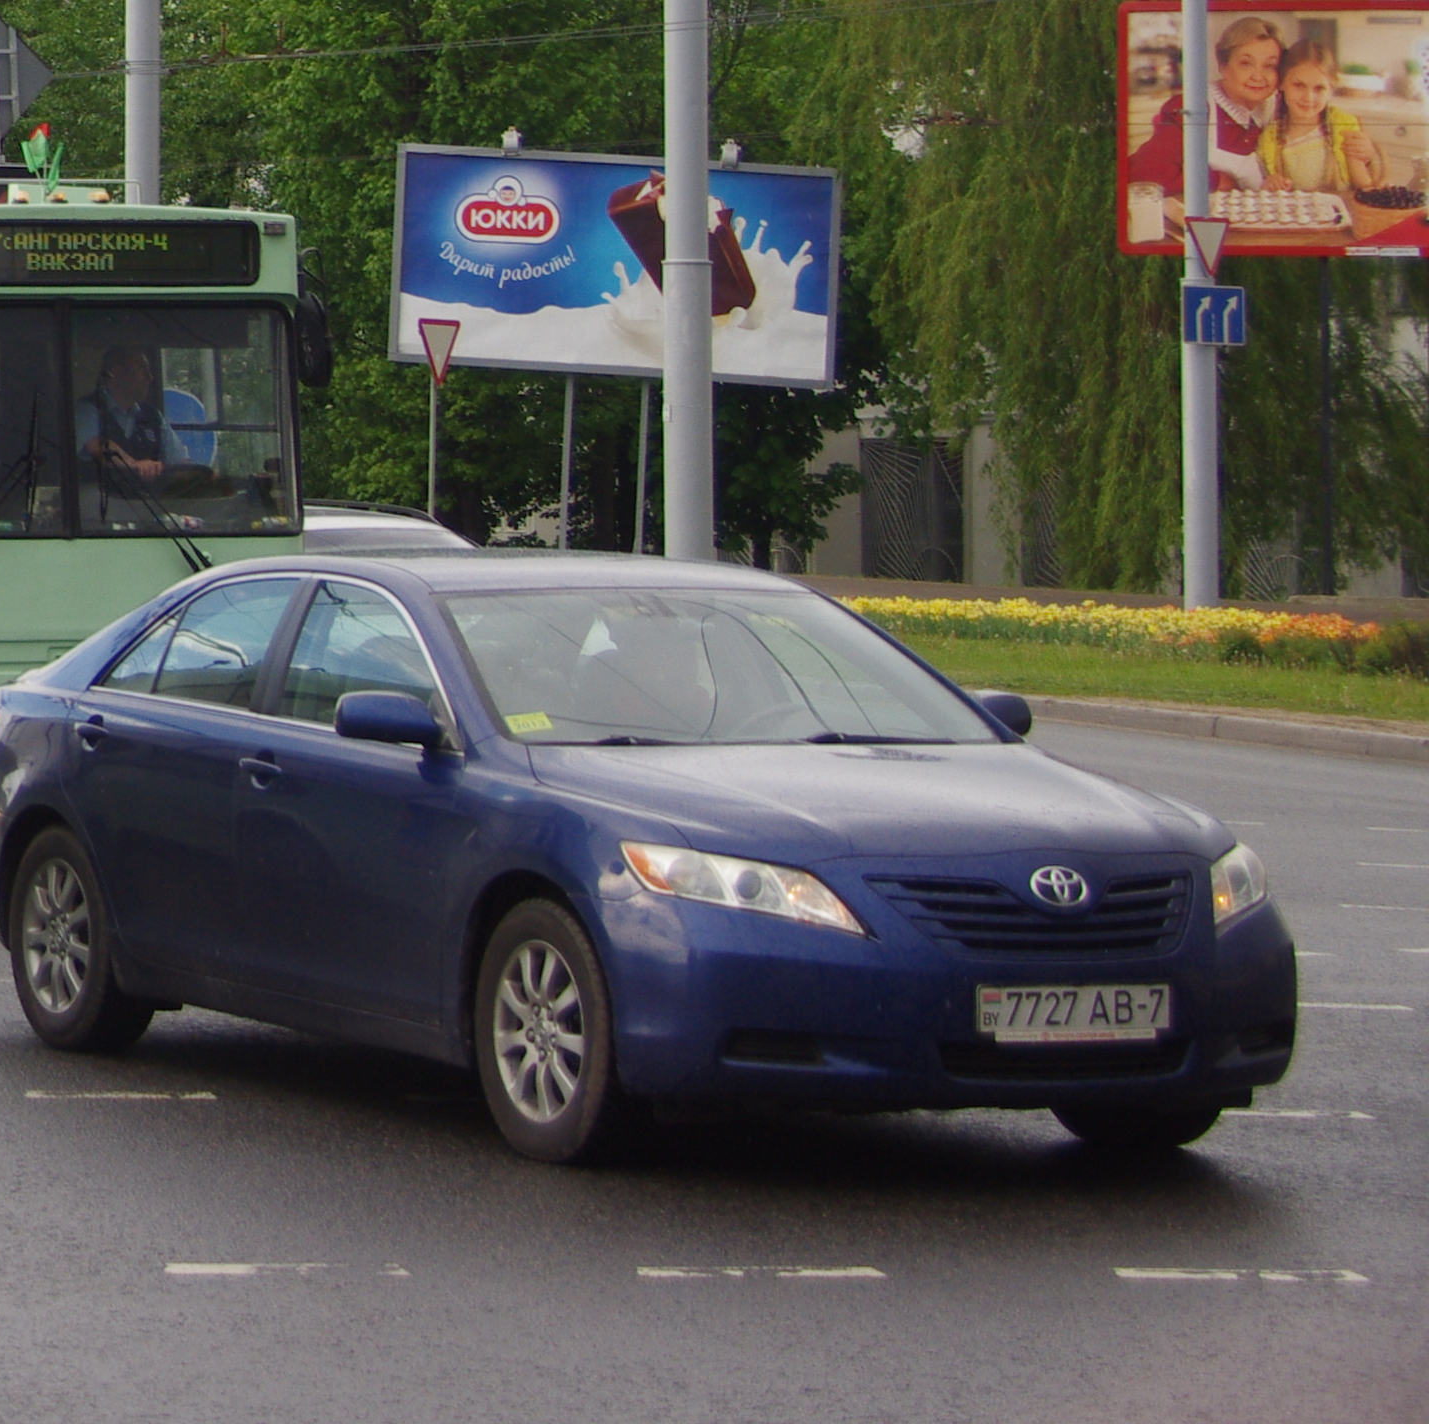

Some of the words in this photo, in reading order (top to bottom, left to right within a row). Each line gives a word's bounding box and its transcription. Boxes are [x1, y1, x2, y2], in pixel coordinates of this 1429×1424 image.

[470, 208, 545, 231] ЮККИ
[26, 252, 115, 271] ВАКЗАЛ
[438, 240, 495, 280] Дарит
[497, 244, 577, 289] радость!
[983, 1012, 1001, 1026] BY
[1006, 990, 1079, 1027] 7727
[1088, 988, 1165, 1026] AB-7
